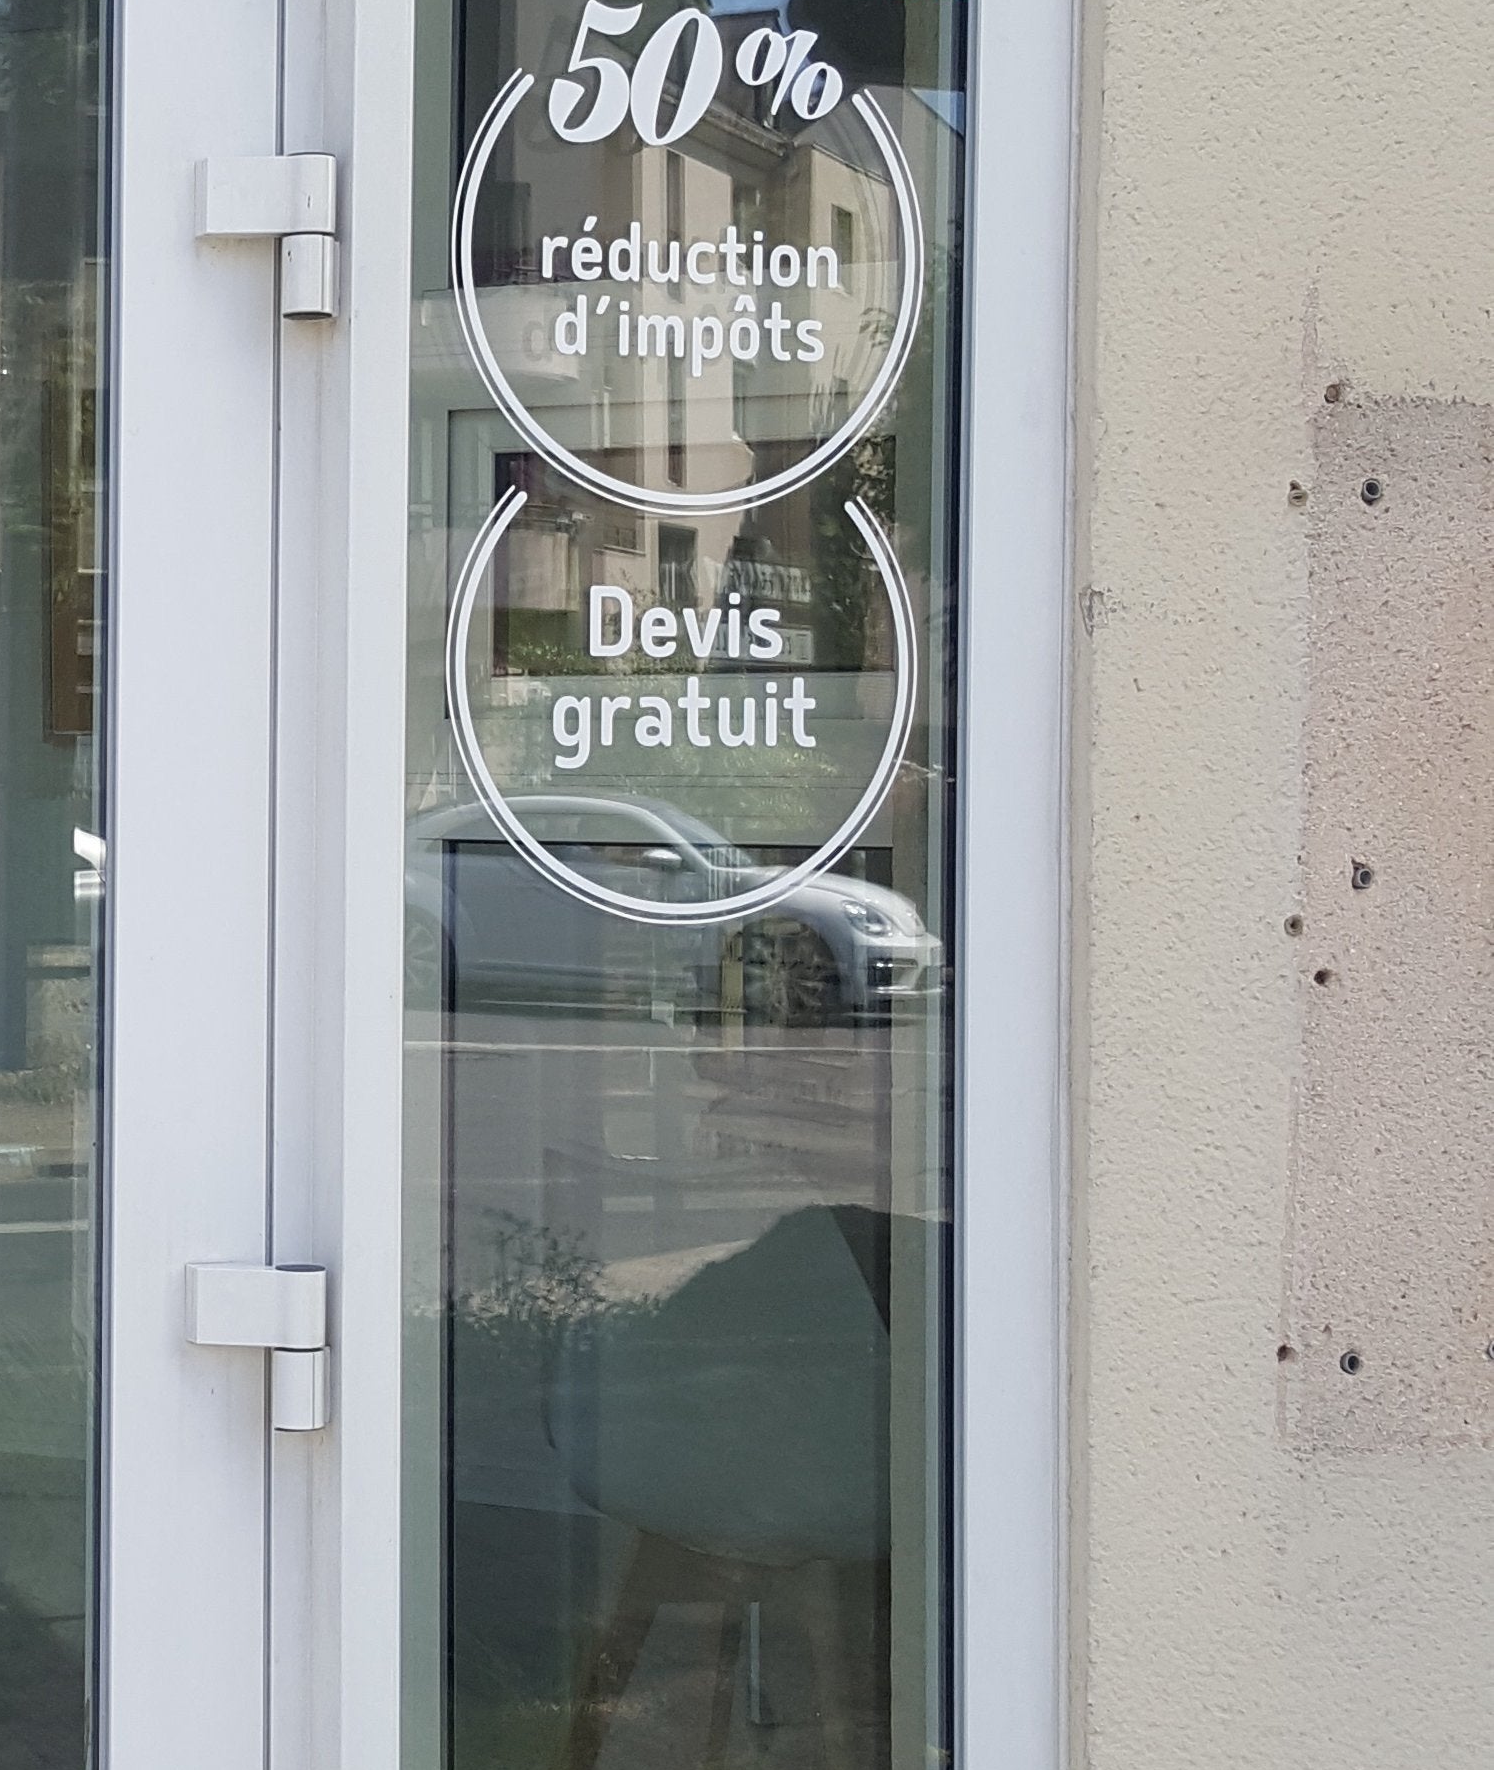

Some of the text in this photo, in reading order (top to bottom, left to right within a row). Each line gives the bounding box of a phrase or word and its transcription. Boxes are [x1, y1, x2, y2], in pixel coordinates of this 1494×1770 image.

[541, 215, 839, 290] réduction
[553, 295, 826, 378] d'impôts
[589, 585, 783, 659] Devis
[552, 675, 817, 769] gratuit
